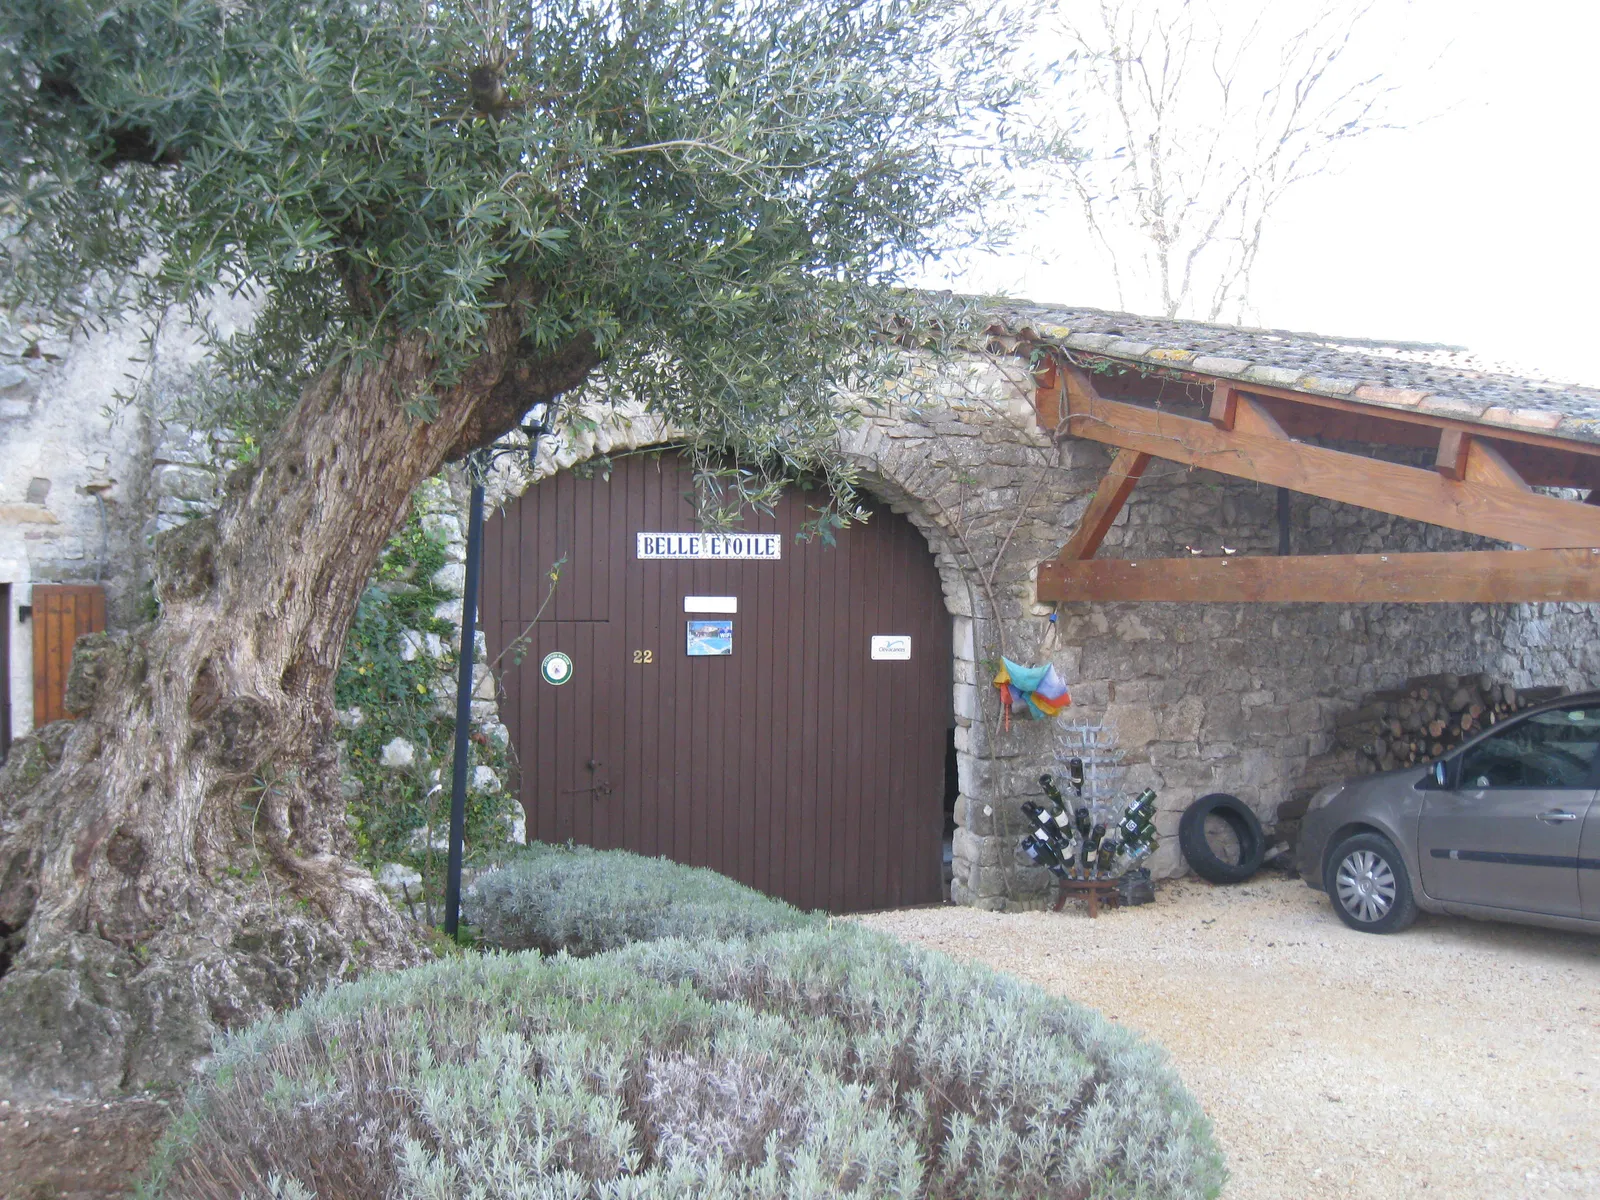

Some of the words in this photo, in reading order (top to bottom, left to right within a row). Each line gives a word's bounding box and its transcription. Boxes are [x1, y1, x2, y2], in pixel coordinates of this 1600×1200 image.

[644, 536, 699, 556] BELLE
[711, 537, 775, 556] ETOILE
[633, 650, 653, 664] 22
